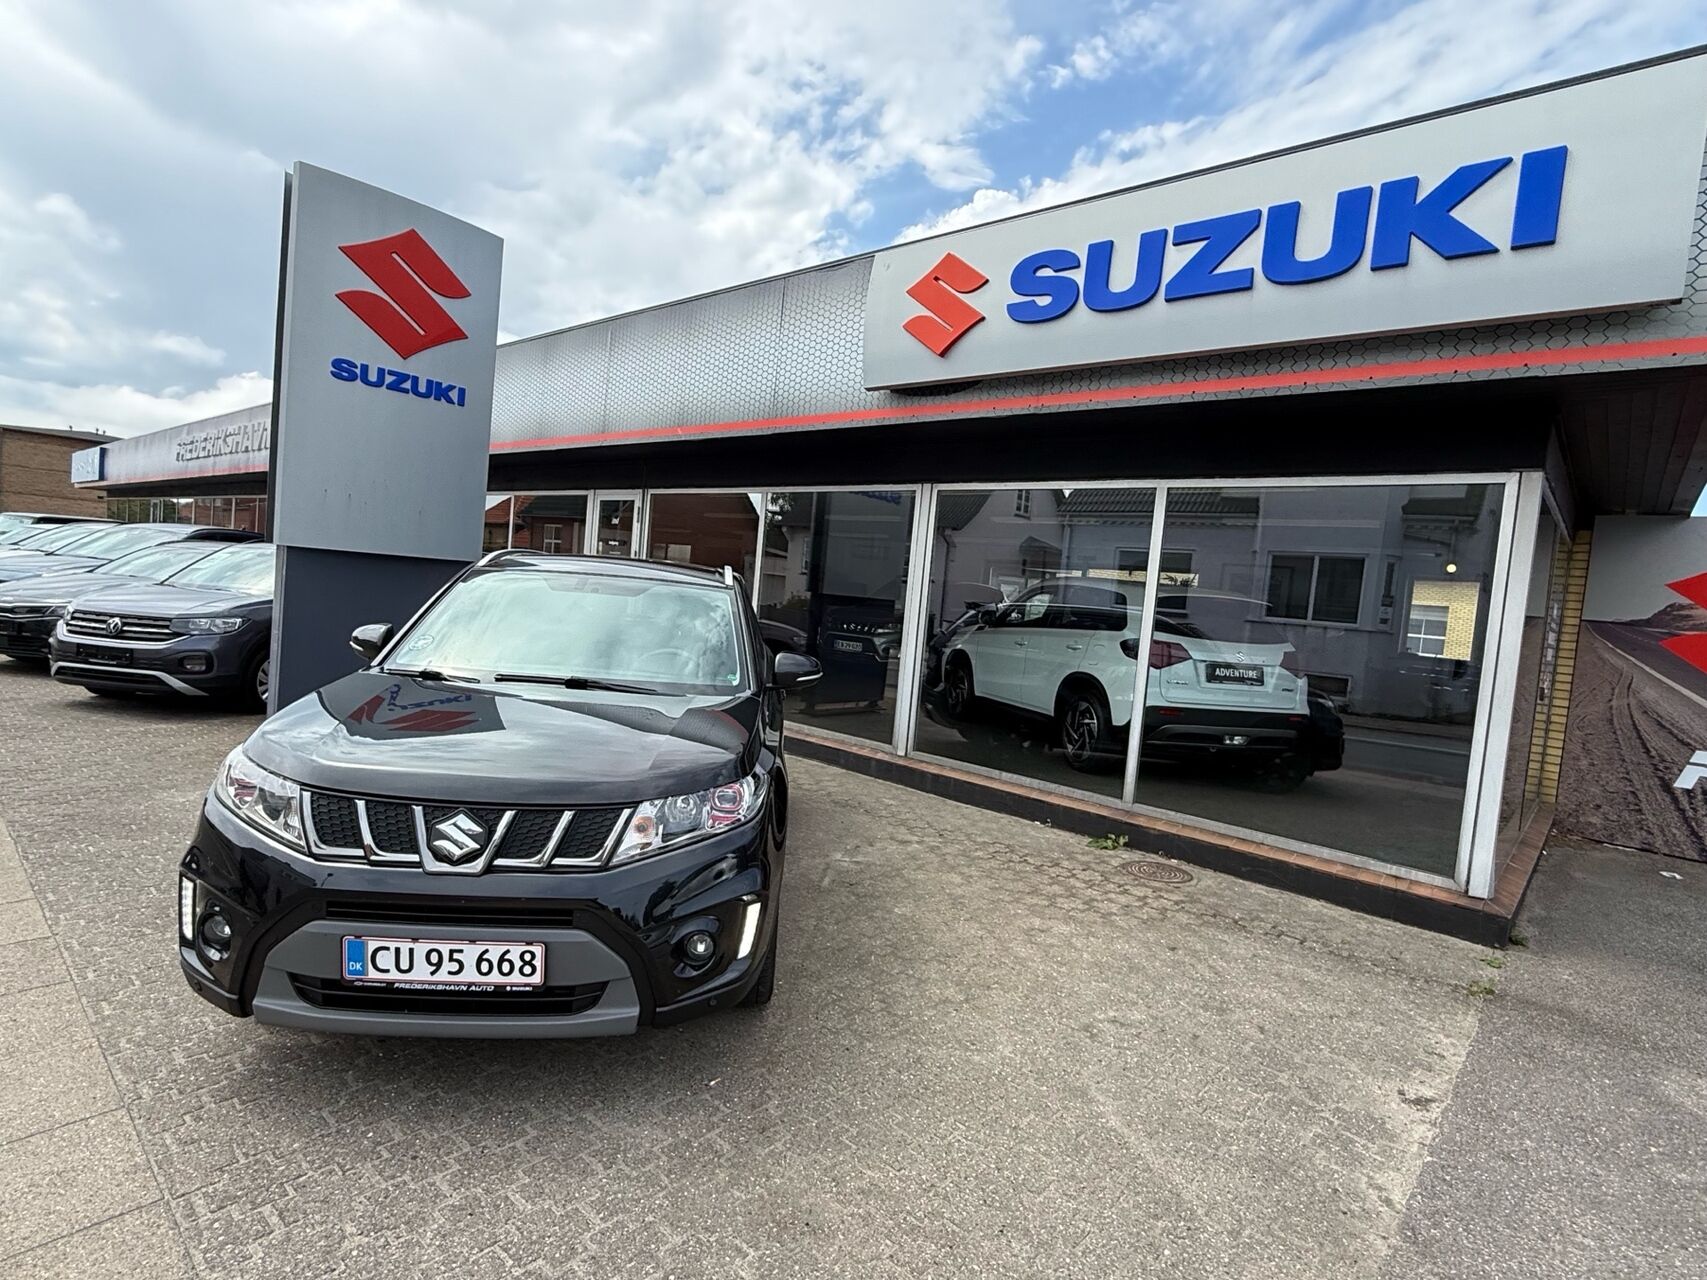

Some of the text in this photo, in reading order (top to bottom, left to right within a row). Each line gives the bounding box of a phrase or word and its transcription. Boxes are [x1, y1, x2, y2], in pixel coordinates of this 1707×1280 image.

[1006, 146, 1568, 324] SUZUKI
[330, 358, 466, 407] SUZUKI
[1215, 667, 1258, 679] ADVENTURE
[349, 946, 537, 977] DK CU 95 668
